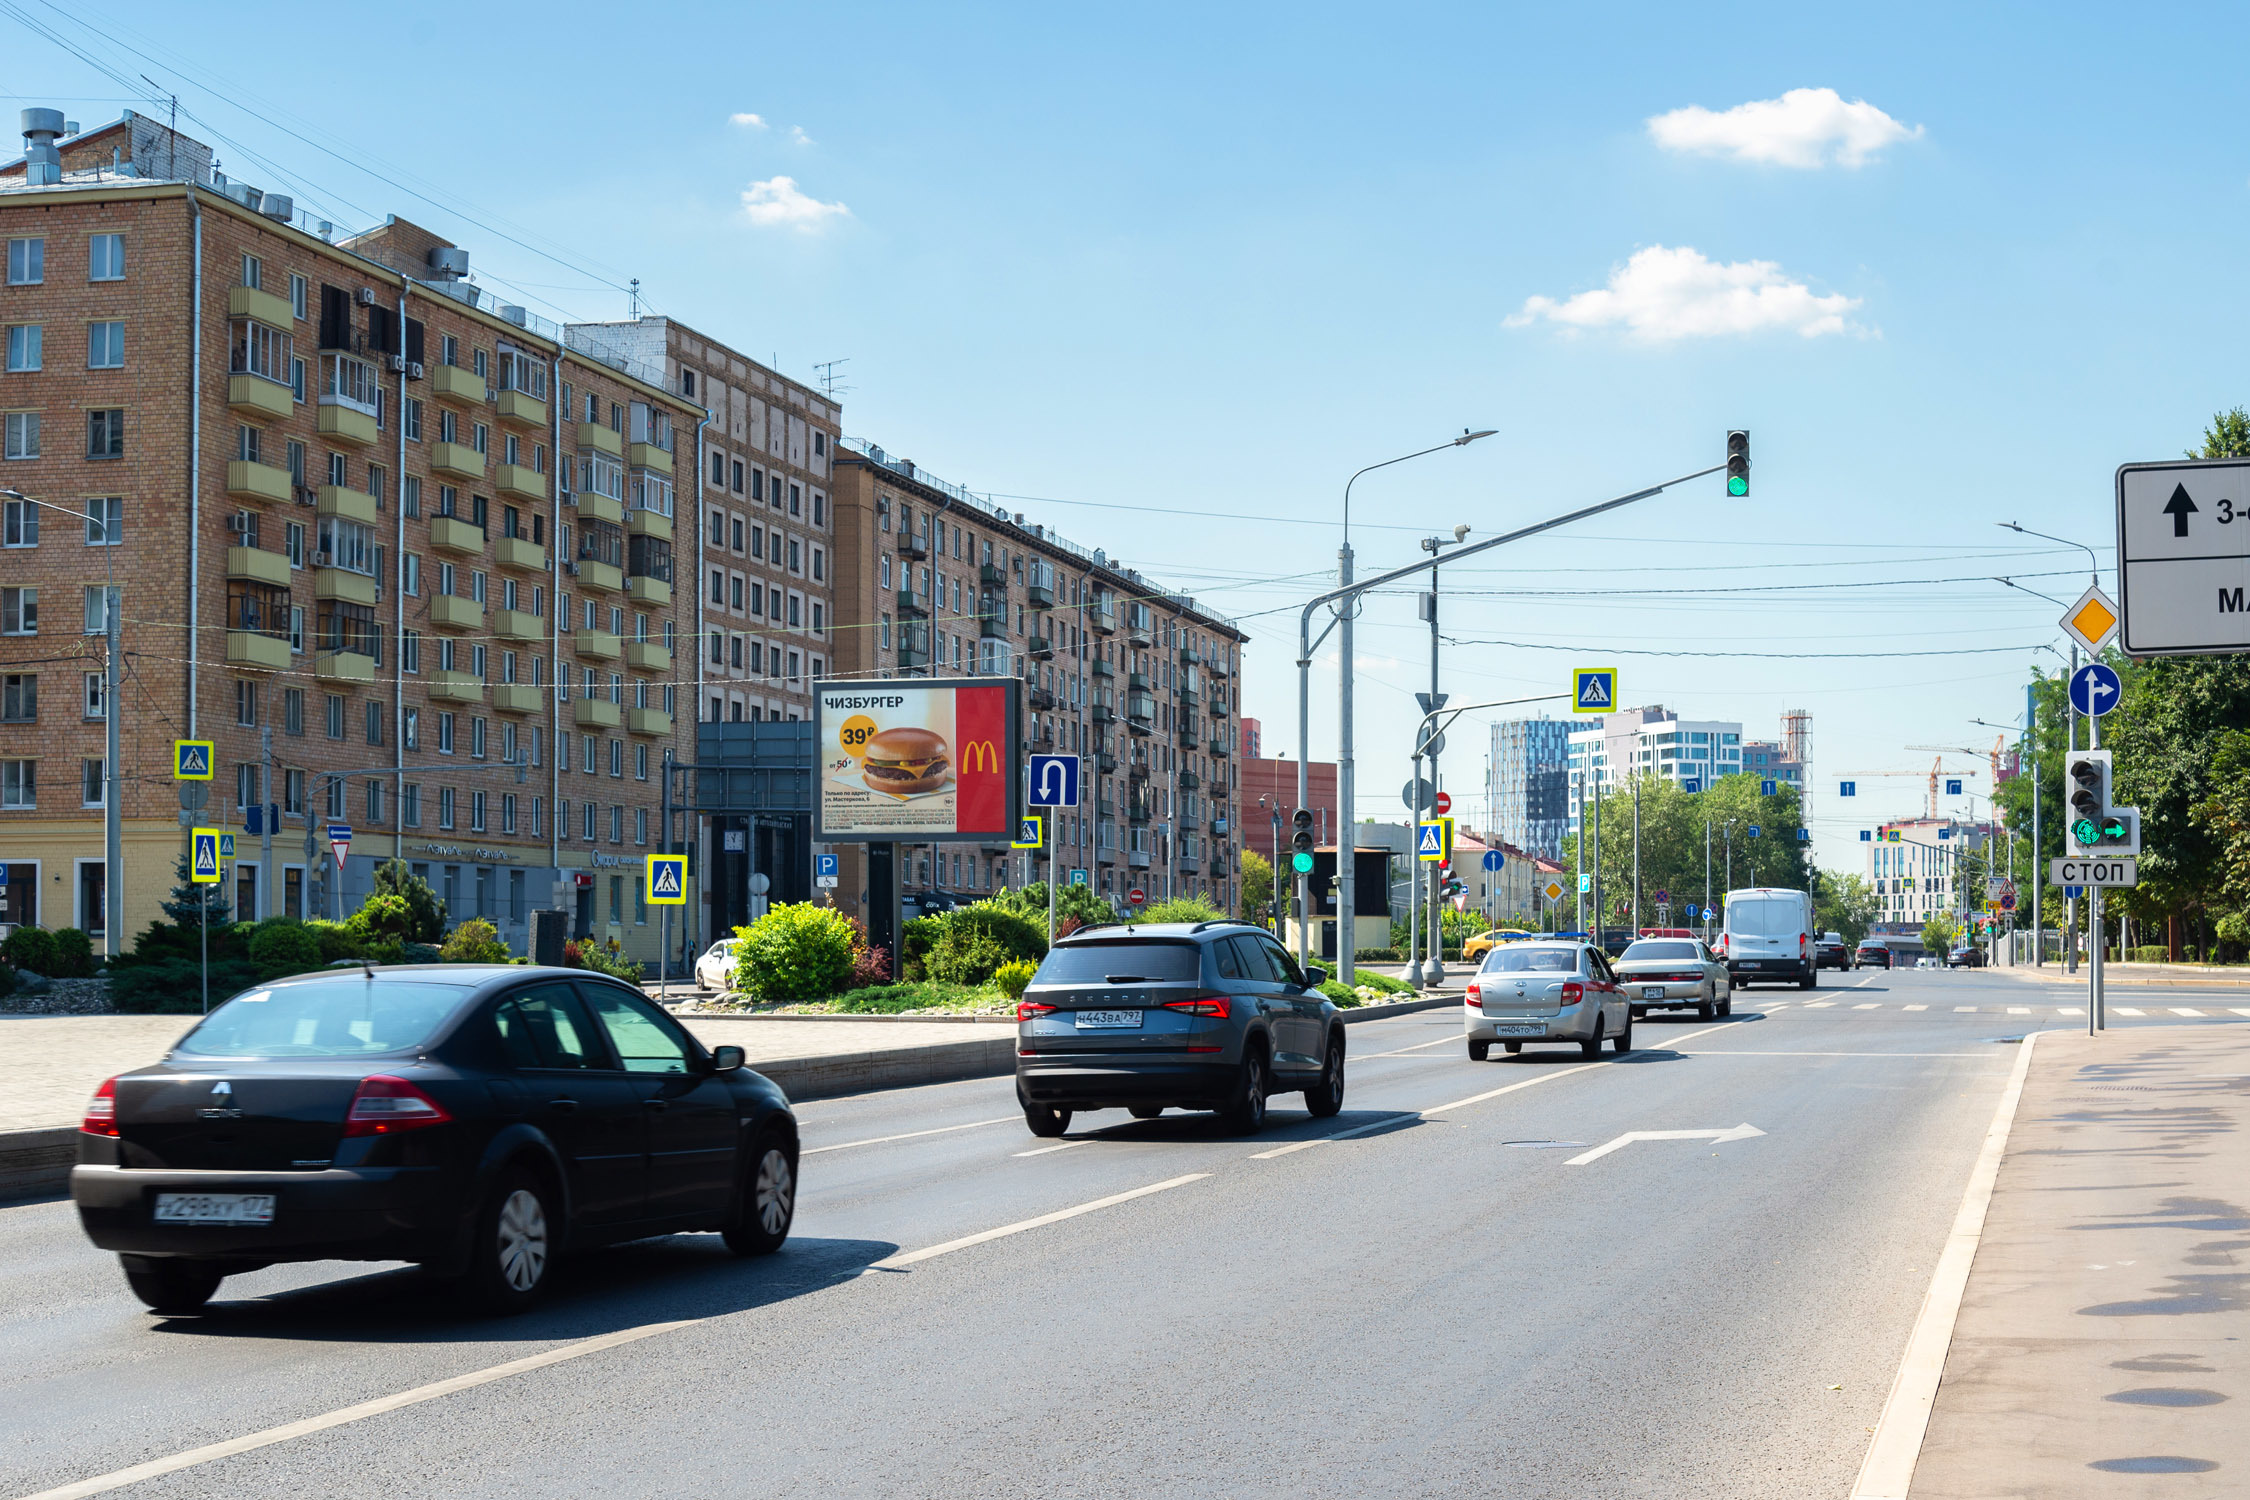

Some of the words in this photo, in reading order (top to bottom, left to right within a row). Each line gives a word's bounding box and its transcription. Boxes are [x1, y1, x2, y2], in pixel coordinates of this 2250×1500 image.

[2216, 499, 2250, 525] 3-
[825, 696, 904, 709] ЧИЗБУРГЕР
[2062, 863, 2124, 881] СТОП
[1122, 1011, 1140, 1020] 797
